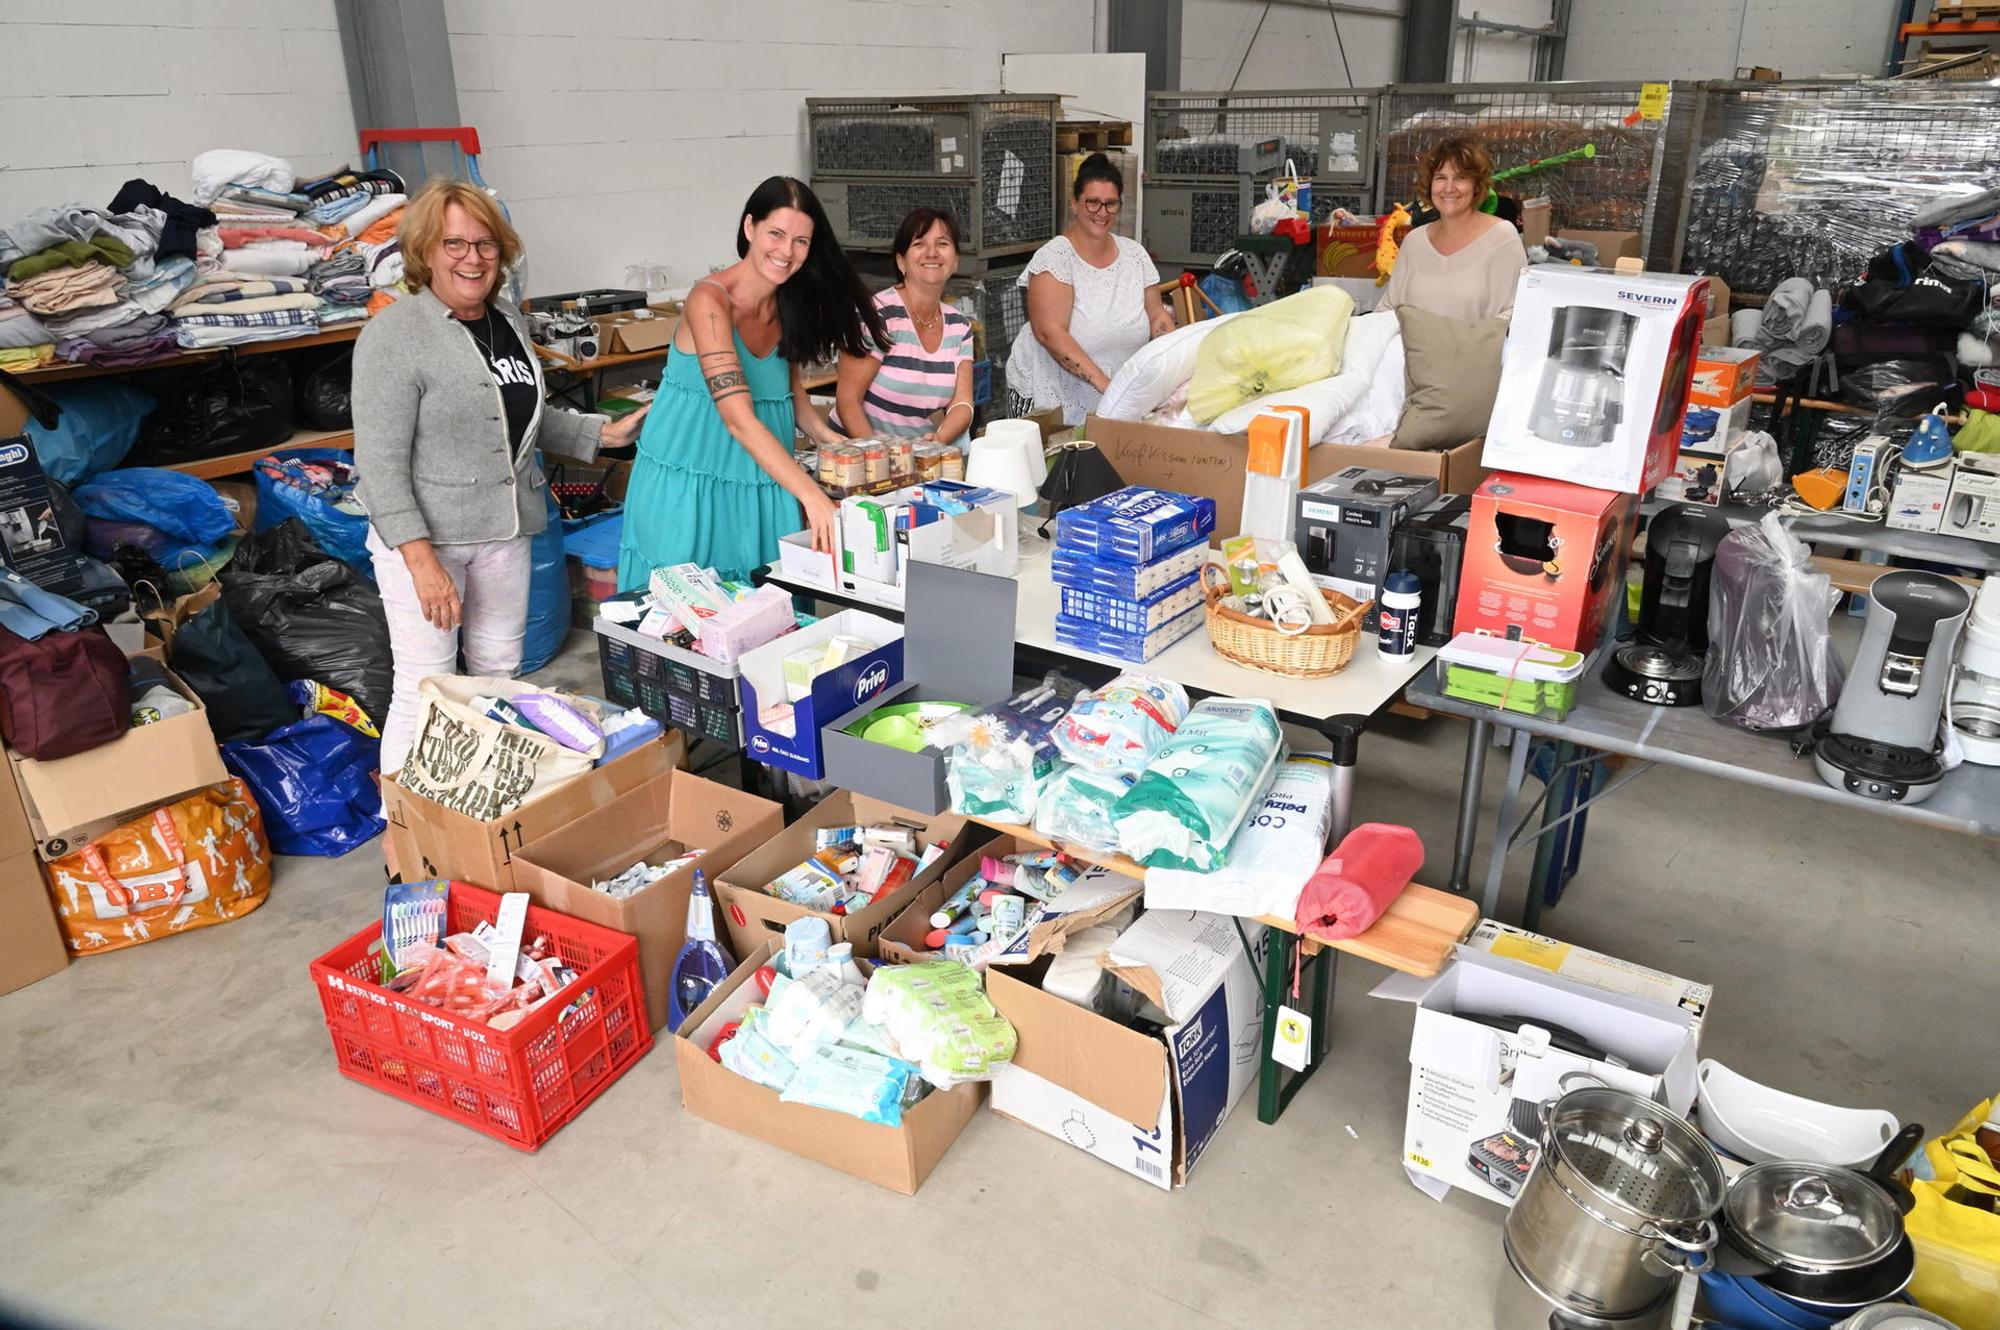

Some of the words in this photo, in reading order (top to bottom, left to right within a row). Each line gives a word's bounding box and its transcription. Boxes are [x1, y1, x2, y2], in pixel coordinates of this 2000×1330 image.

[1617, 290, 1677, 305] SEVERIN
[1406, 613, 1418, 648] Tacx
[857, 668, 886, 700] Priva
[51, 839, 62, 851] 6
[1179, 1028, 1202, 1054] TORK
